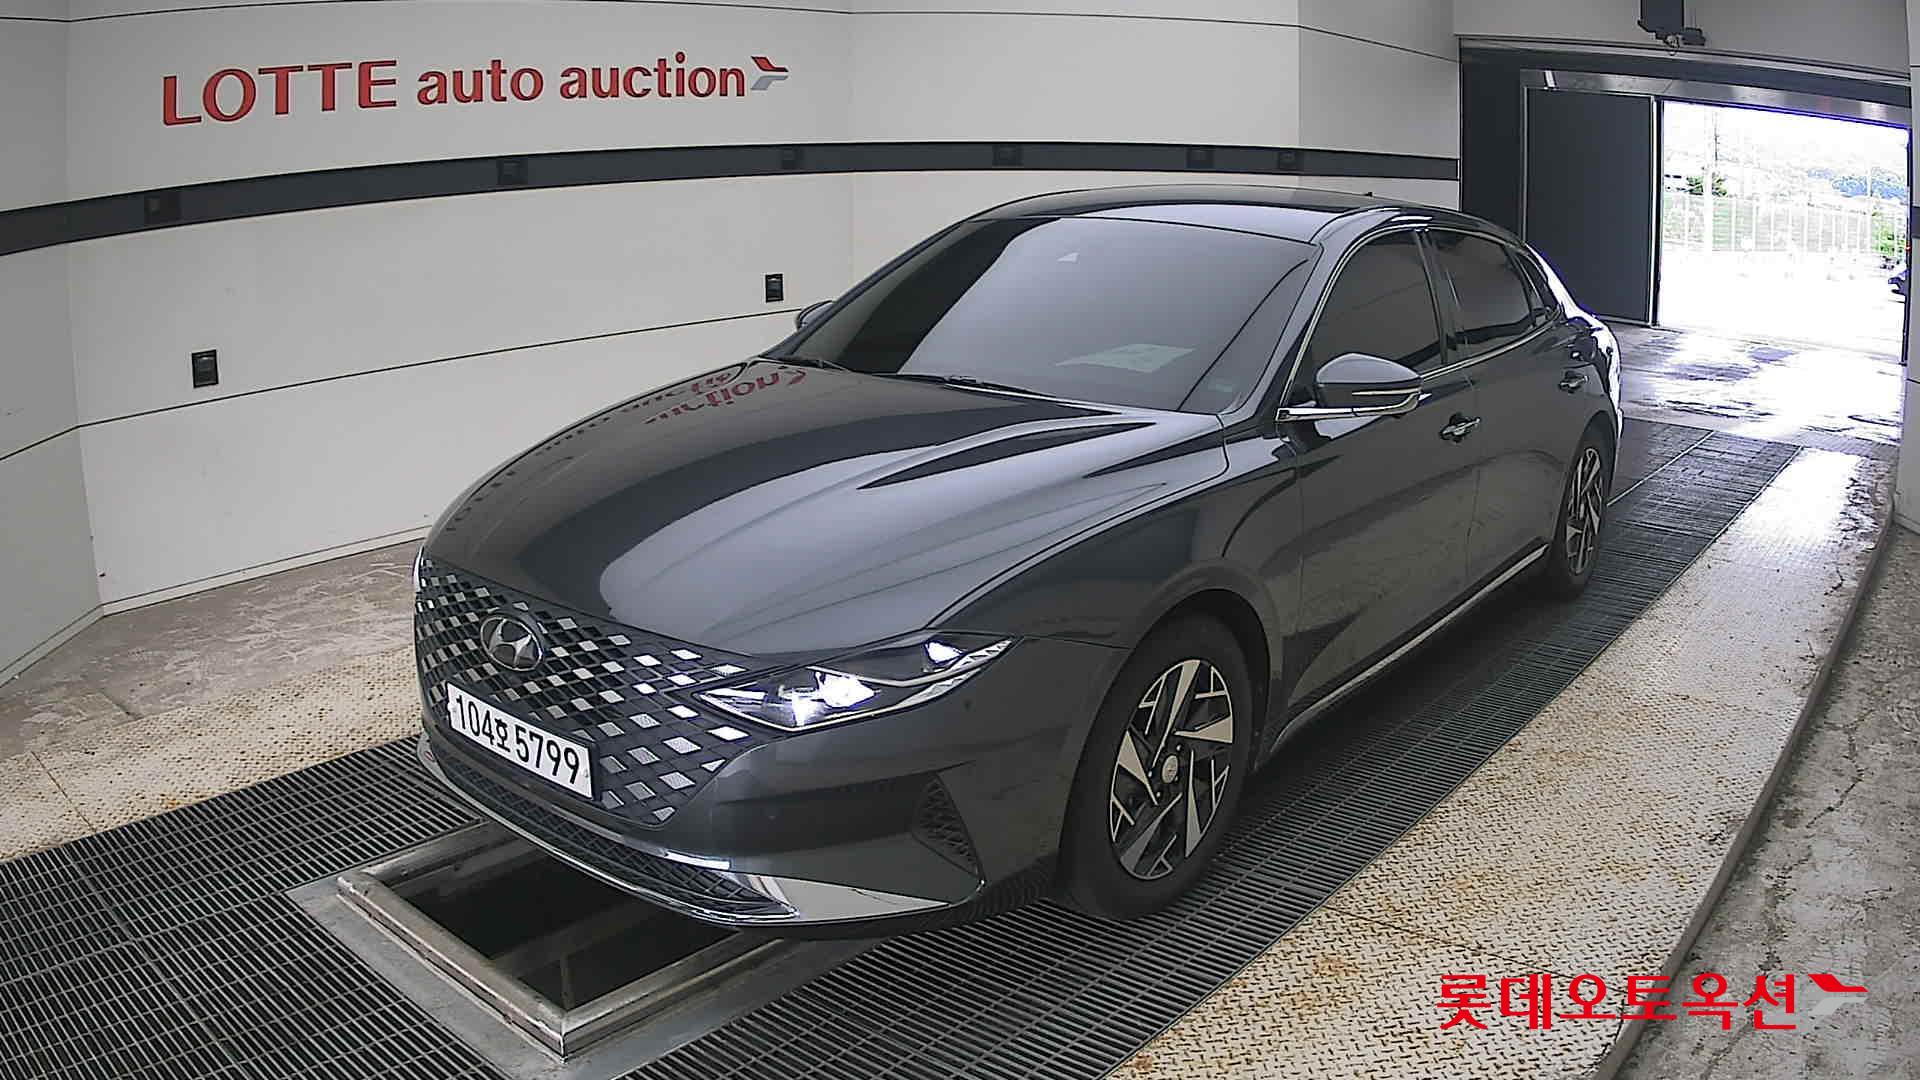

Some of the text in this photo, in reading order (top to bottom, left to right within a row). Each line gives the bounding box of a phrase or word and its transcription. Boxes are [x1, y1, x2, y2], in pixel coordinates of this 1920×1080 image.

[162, 51, 747, 127] LOTTE auto auction
[456, 695, 579, 784] 104호 5799
